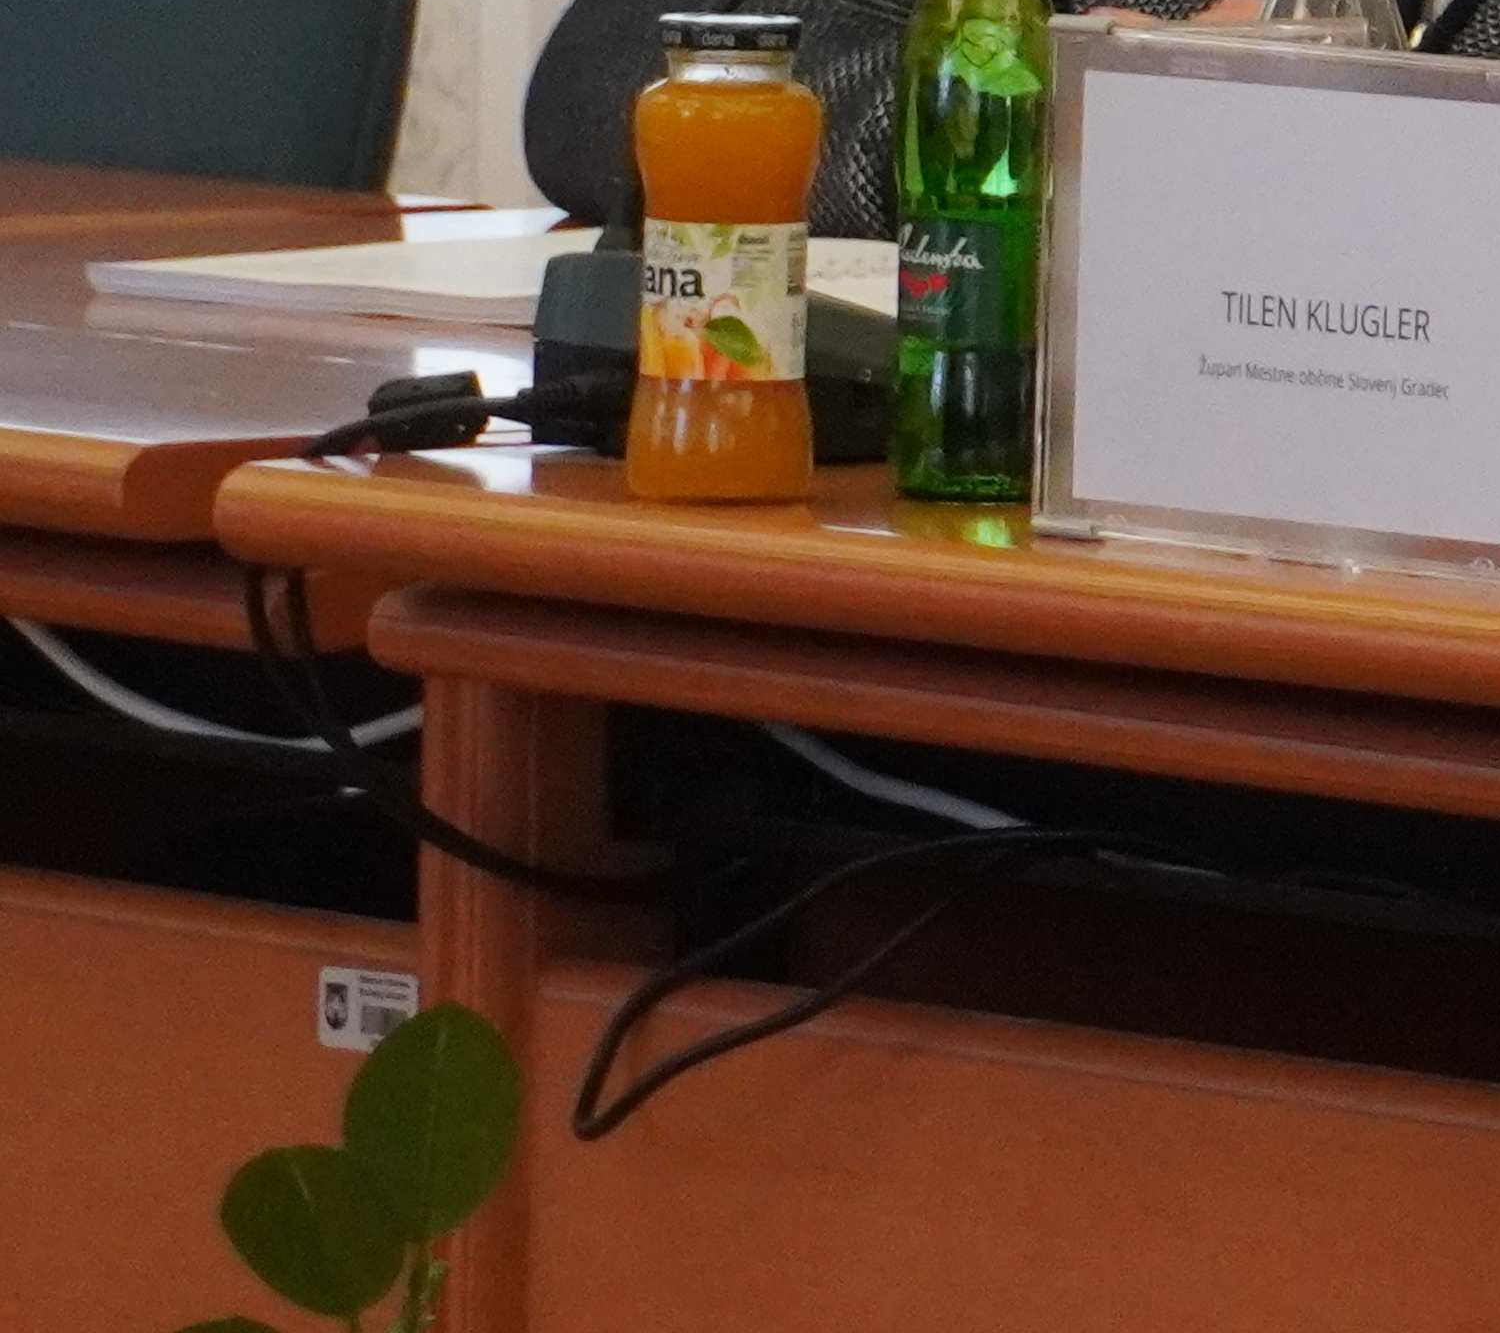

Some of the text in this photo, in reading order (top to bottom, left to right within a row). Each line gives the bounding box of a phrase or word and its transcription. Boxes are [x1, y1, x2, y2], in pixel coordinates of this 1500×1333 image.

[643, 265, 705, 299] ana
[1221, 290, 1431, 343] TILEN KLUGLER
